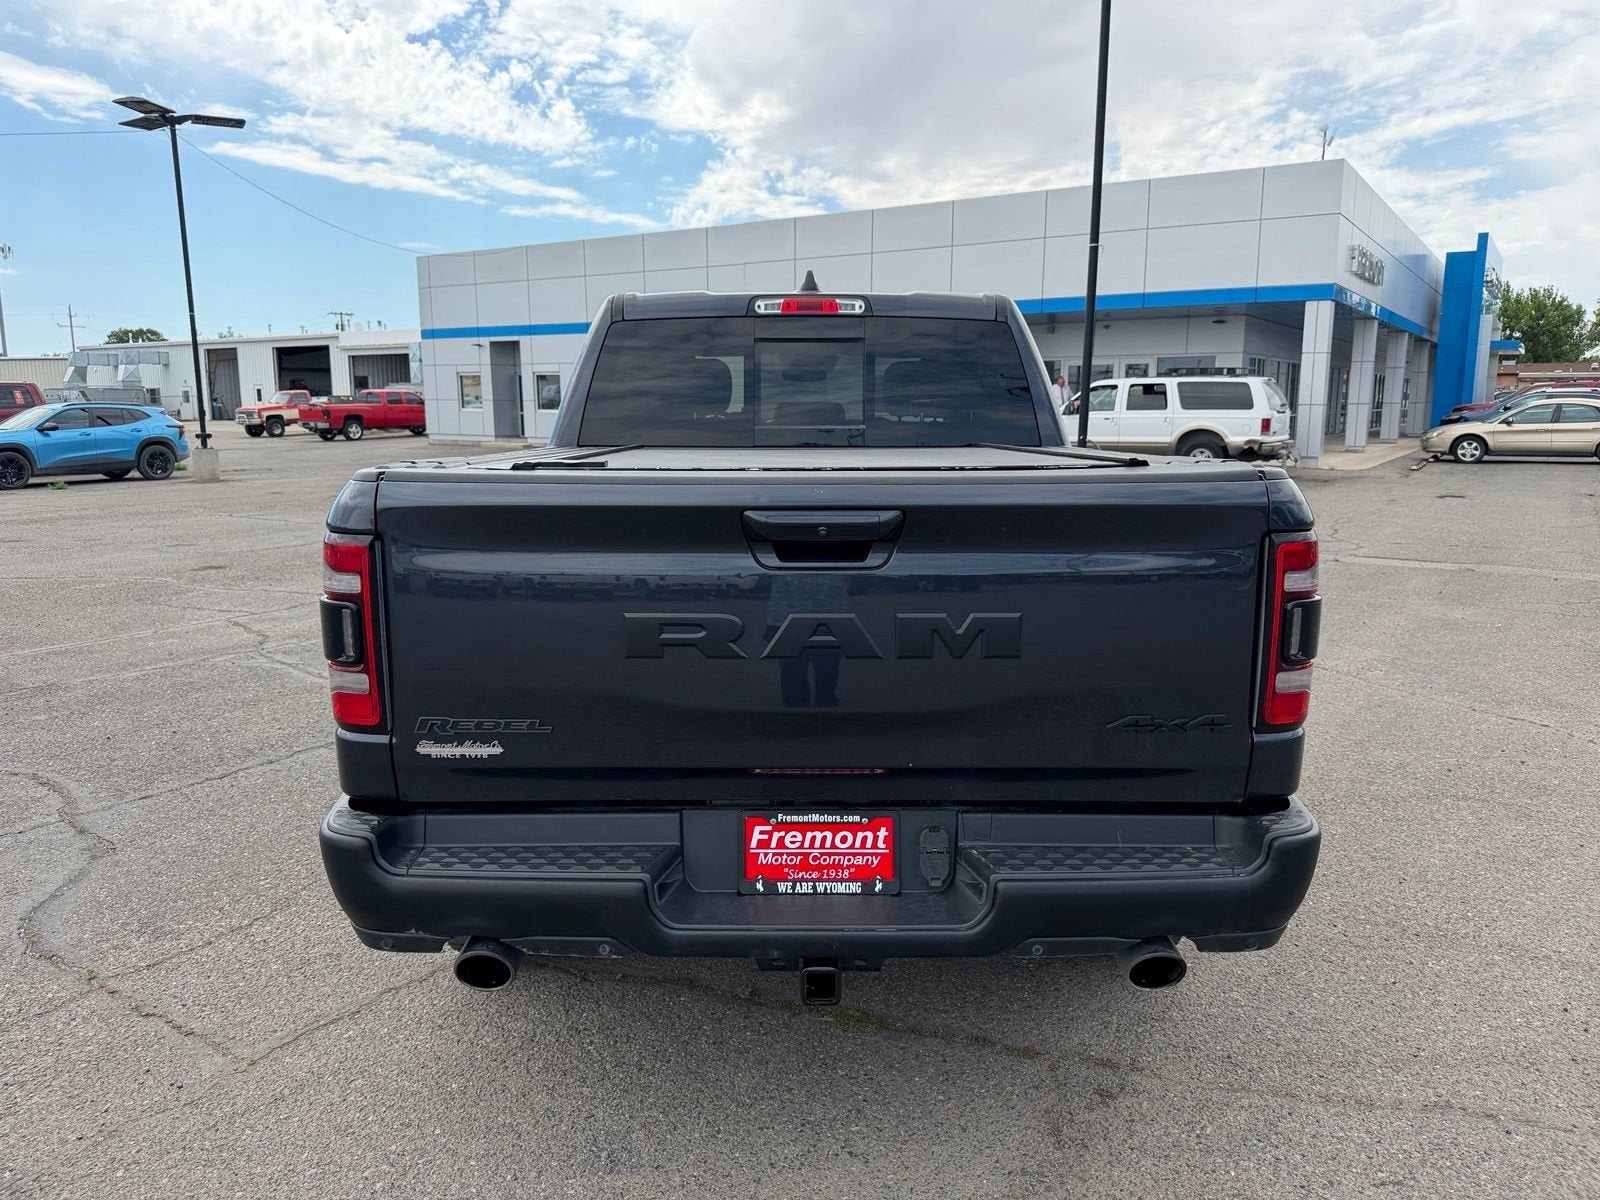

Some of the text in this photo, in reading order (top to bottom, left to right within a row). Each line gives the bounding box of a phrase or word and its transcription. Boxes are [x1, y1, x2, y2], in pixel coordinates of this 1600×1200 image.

[624, 612, 1022, 659] RAM
[414, 716, 553, 735] REBEL
[777, 813, 861, 823] FremontMotors.com
[749, 825, 889, 849] Fremont
[757, 852, 881, 868] Motor Company
[777, 881, 862, 894] WE ARE WYOMING
